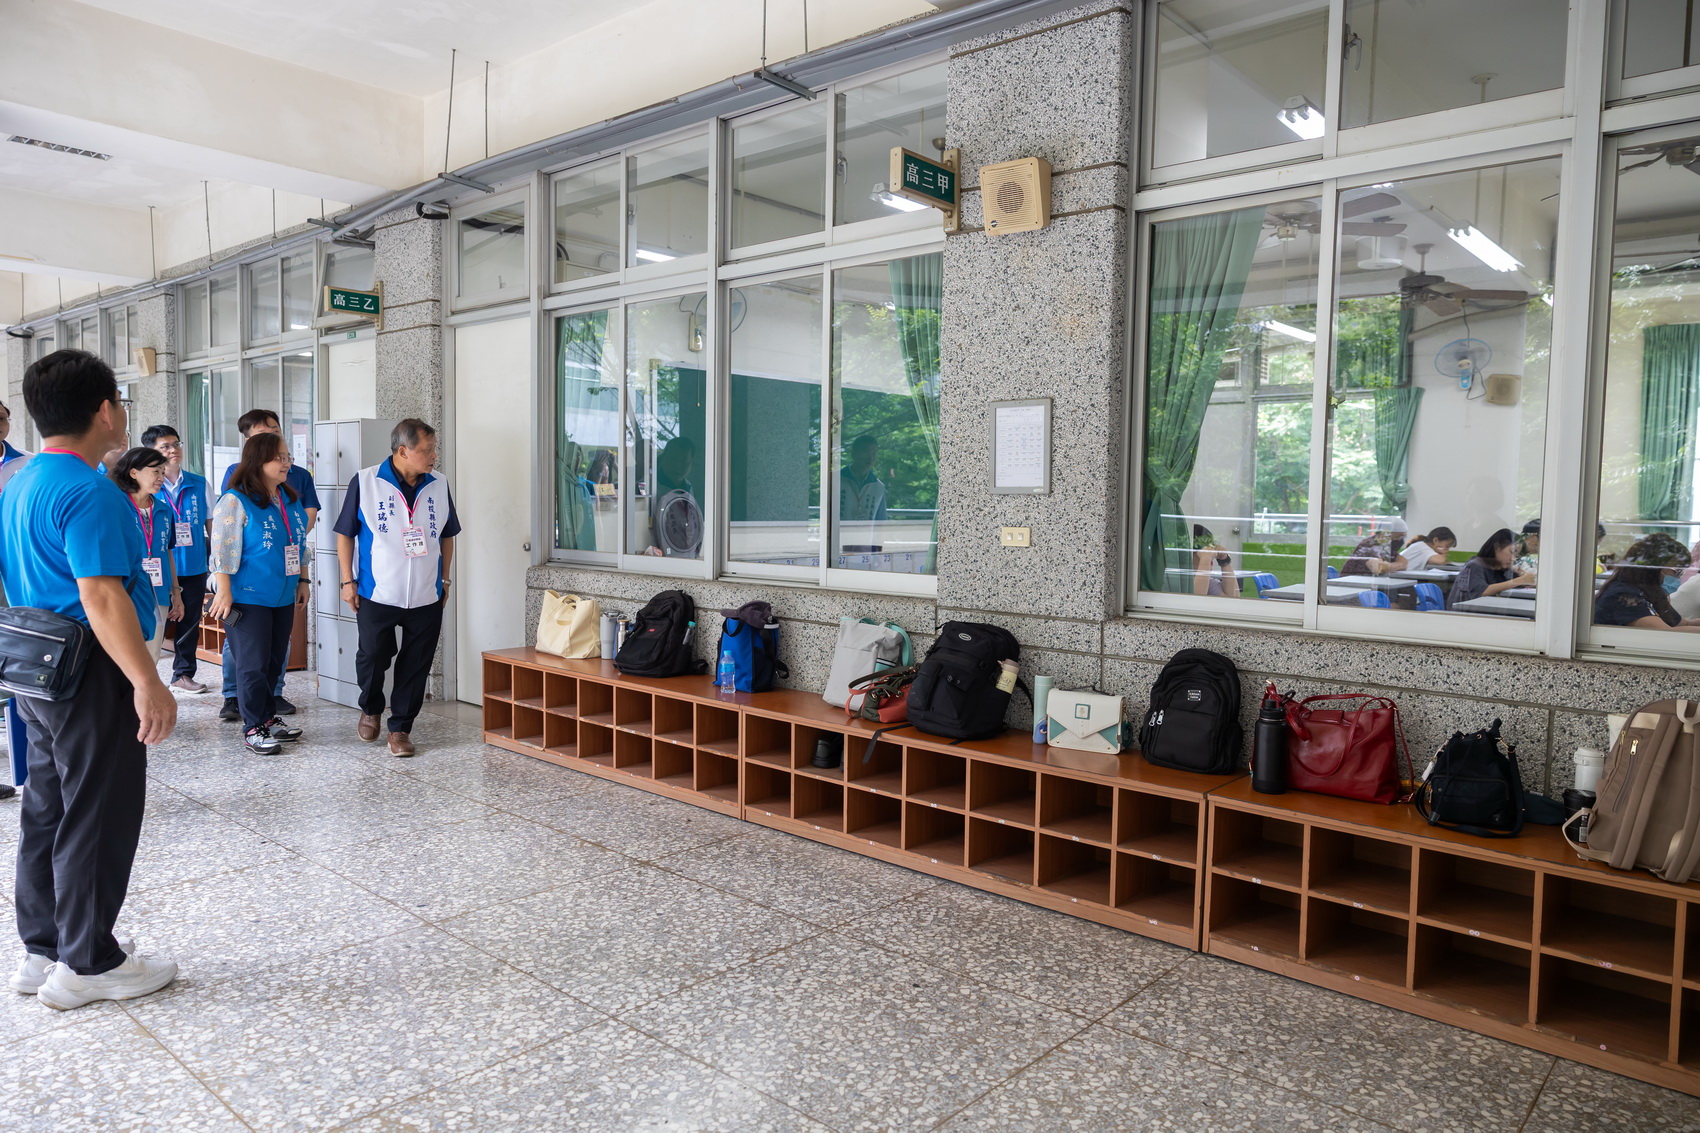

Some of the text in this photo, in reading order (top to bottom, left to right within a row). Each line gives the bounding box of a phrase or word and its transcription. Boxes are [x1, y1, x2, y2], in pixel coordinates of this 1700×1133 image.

[906, 163, 949, 194] 高三甲
[333, 293, 375, 311] 高三乙
[377, 501, 389, 534] 王瑞德
[427, 496, 438, 539] 南投縣政府
[262, 521, 274, 550] 王淑玲
[811, 558, 820, 567] 29
[838, 556, 846, 565] 27
[861, 555, 870, 564] 25
[883, 554, 891, 563] 23
[905, 553, 912, 561] 21
